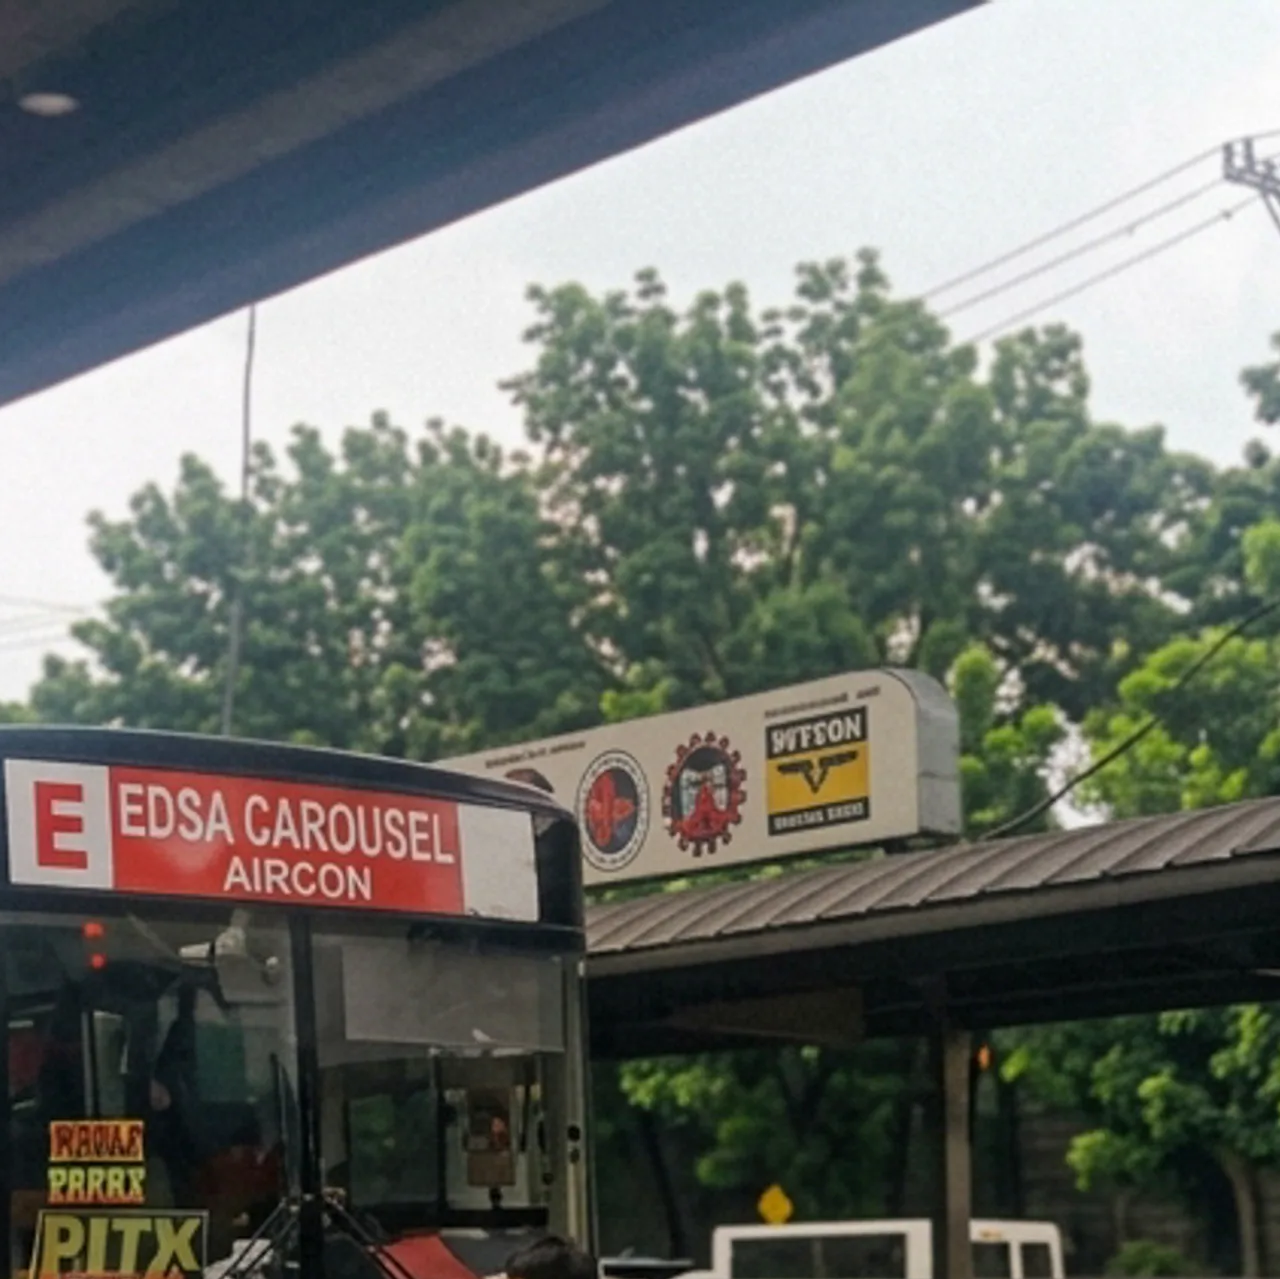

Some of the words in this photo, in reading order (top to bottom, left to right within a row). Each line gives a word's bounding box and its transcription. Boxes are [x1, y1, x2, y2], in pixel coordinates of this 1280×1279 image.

[34, 780, 88, 870] E
[120, 782, 235, 845] EDSA
[244, 794, 455, 864] CAROUSEL
[223, 856, 371, 900] AIRCON
